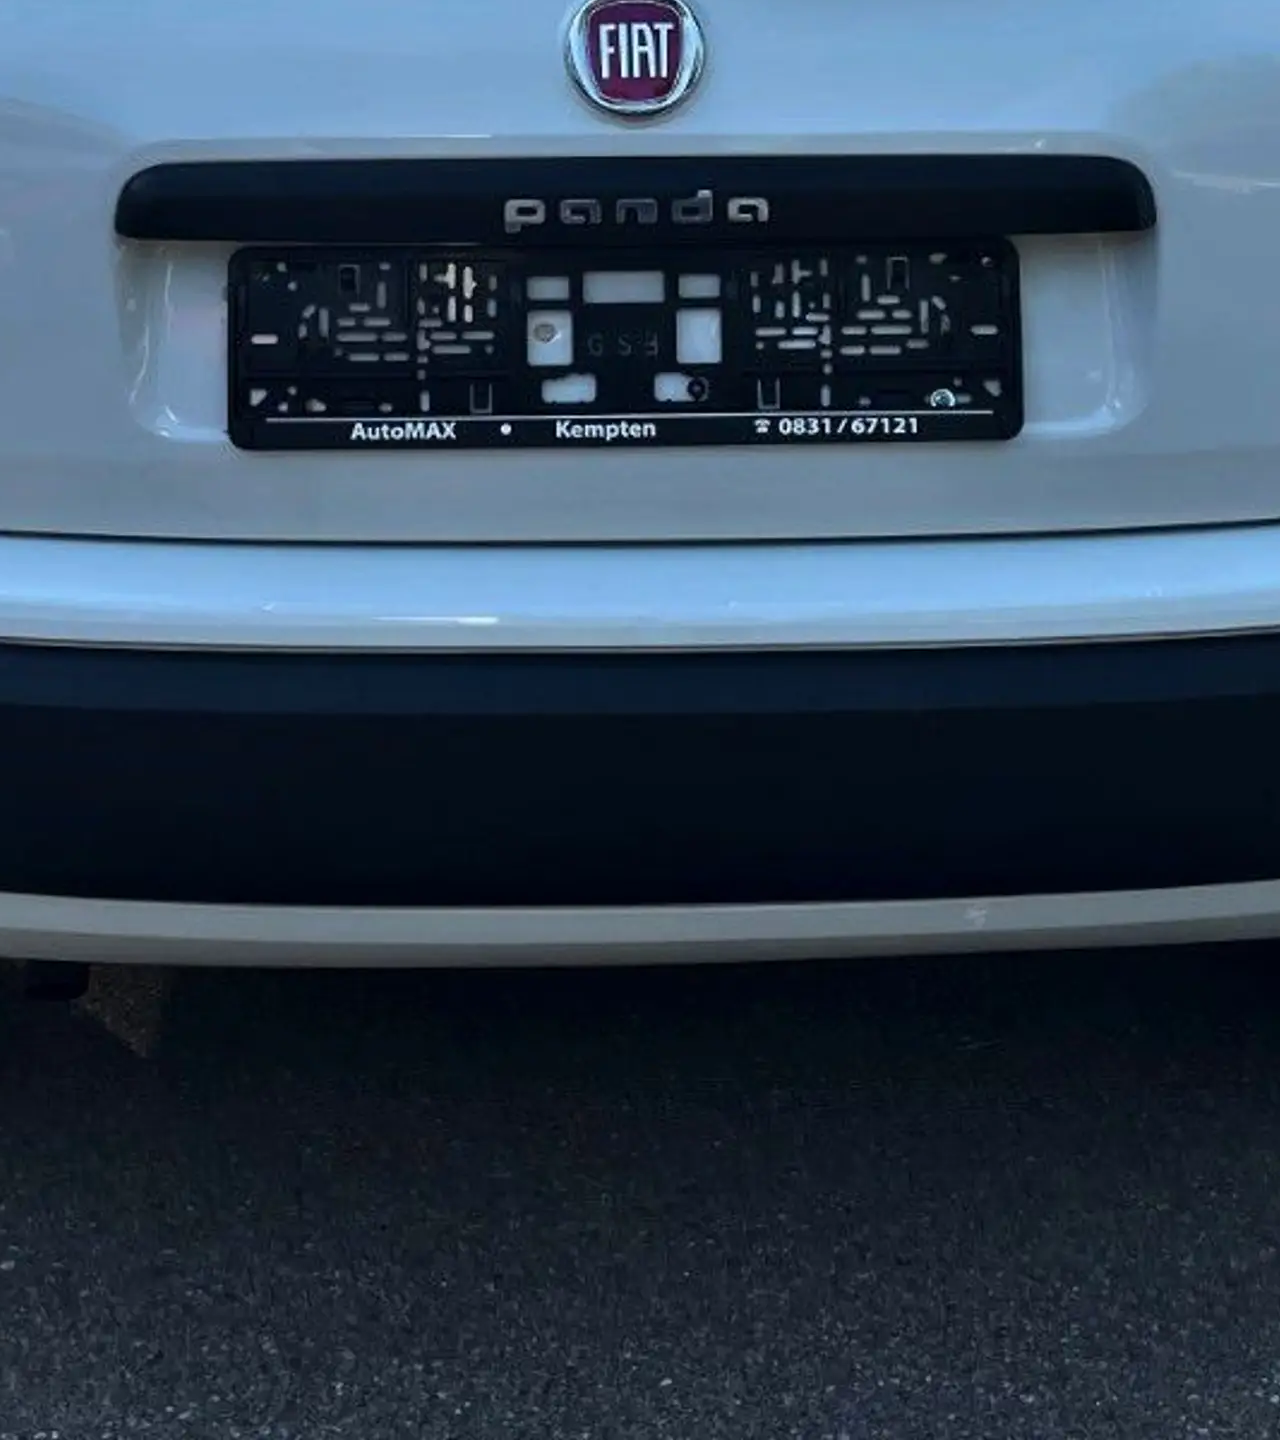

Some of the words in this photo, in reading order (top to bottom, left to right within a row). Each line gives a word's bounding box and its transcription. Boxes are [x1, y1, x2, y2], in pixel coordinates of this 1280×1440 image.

[599, 22, 674, 79] FIAT
[503, 189, 770, 234] panda
[350, 421, 457, 441] AutoMAX
[554, 419, 657, 442] Kempten
